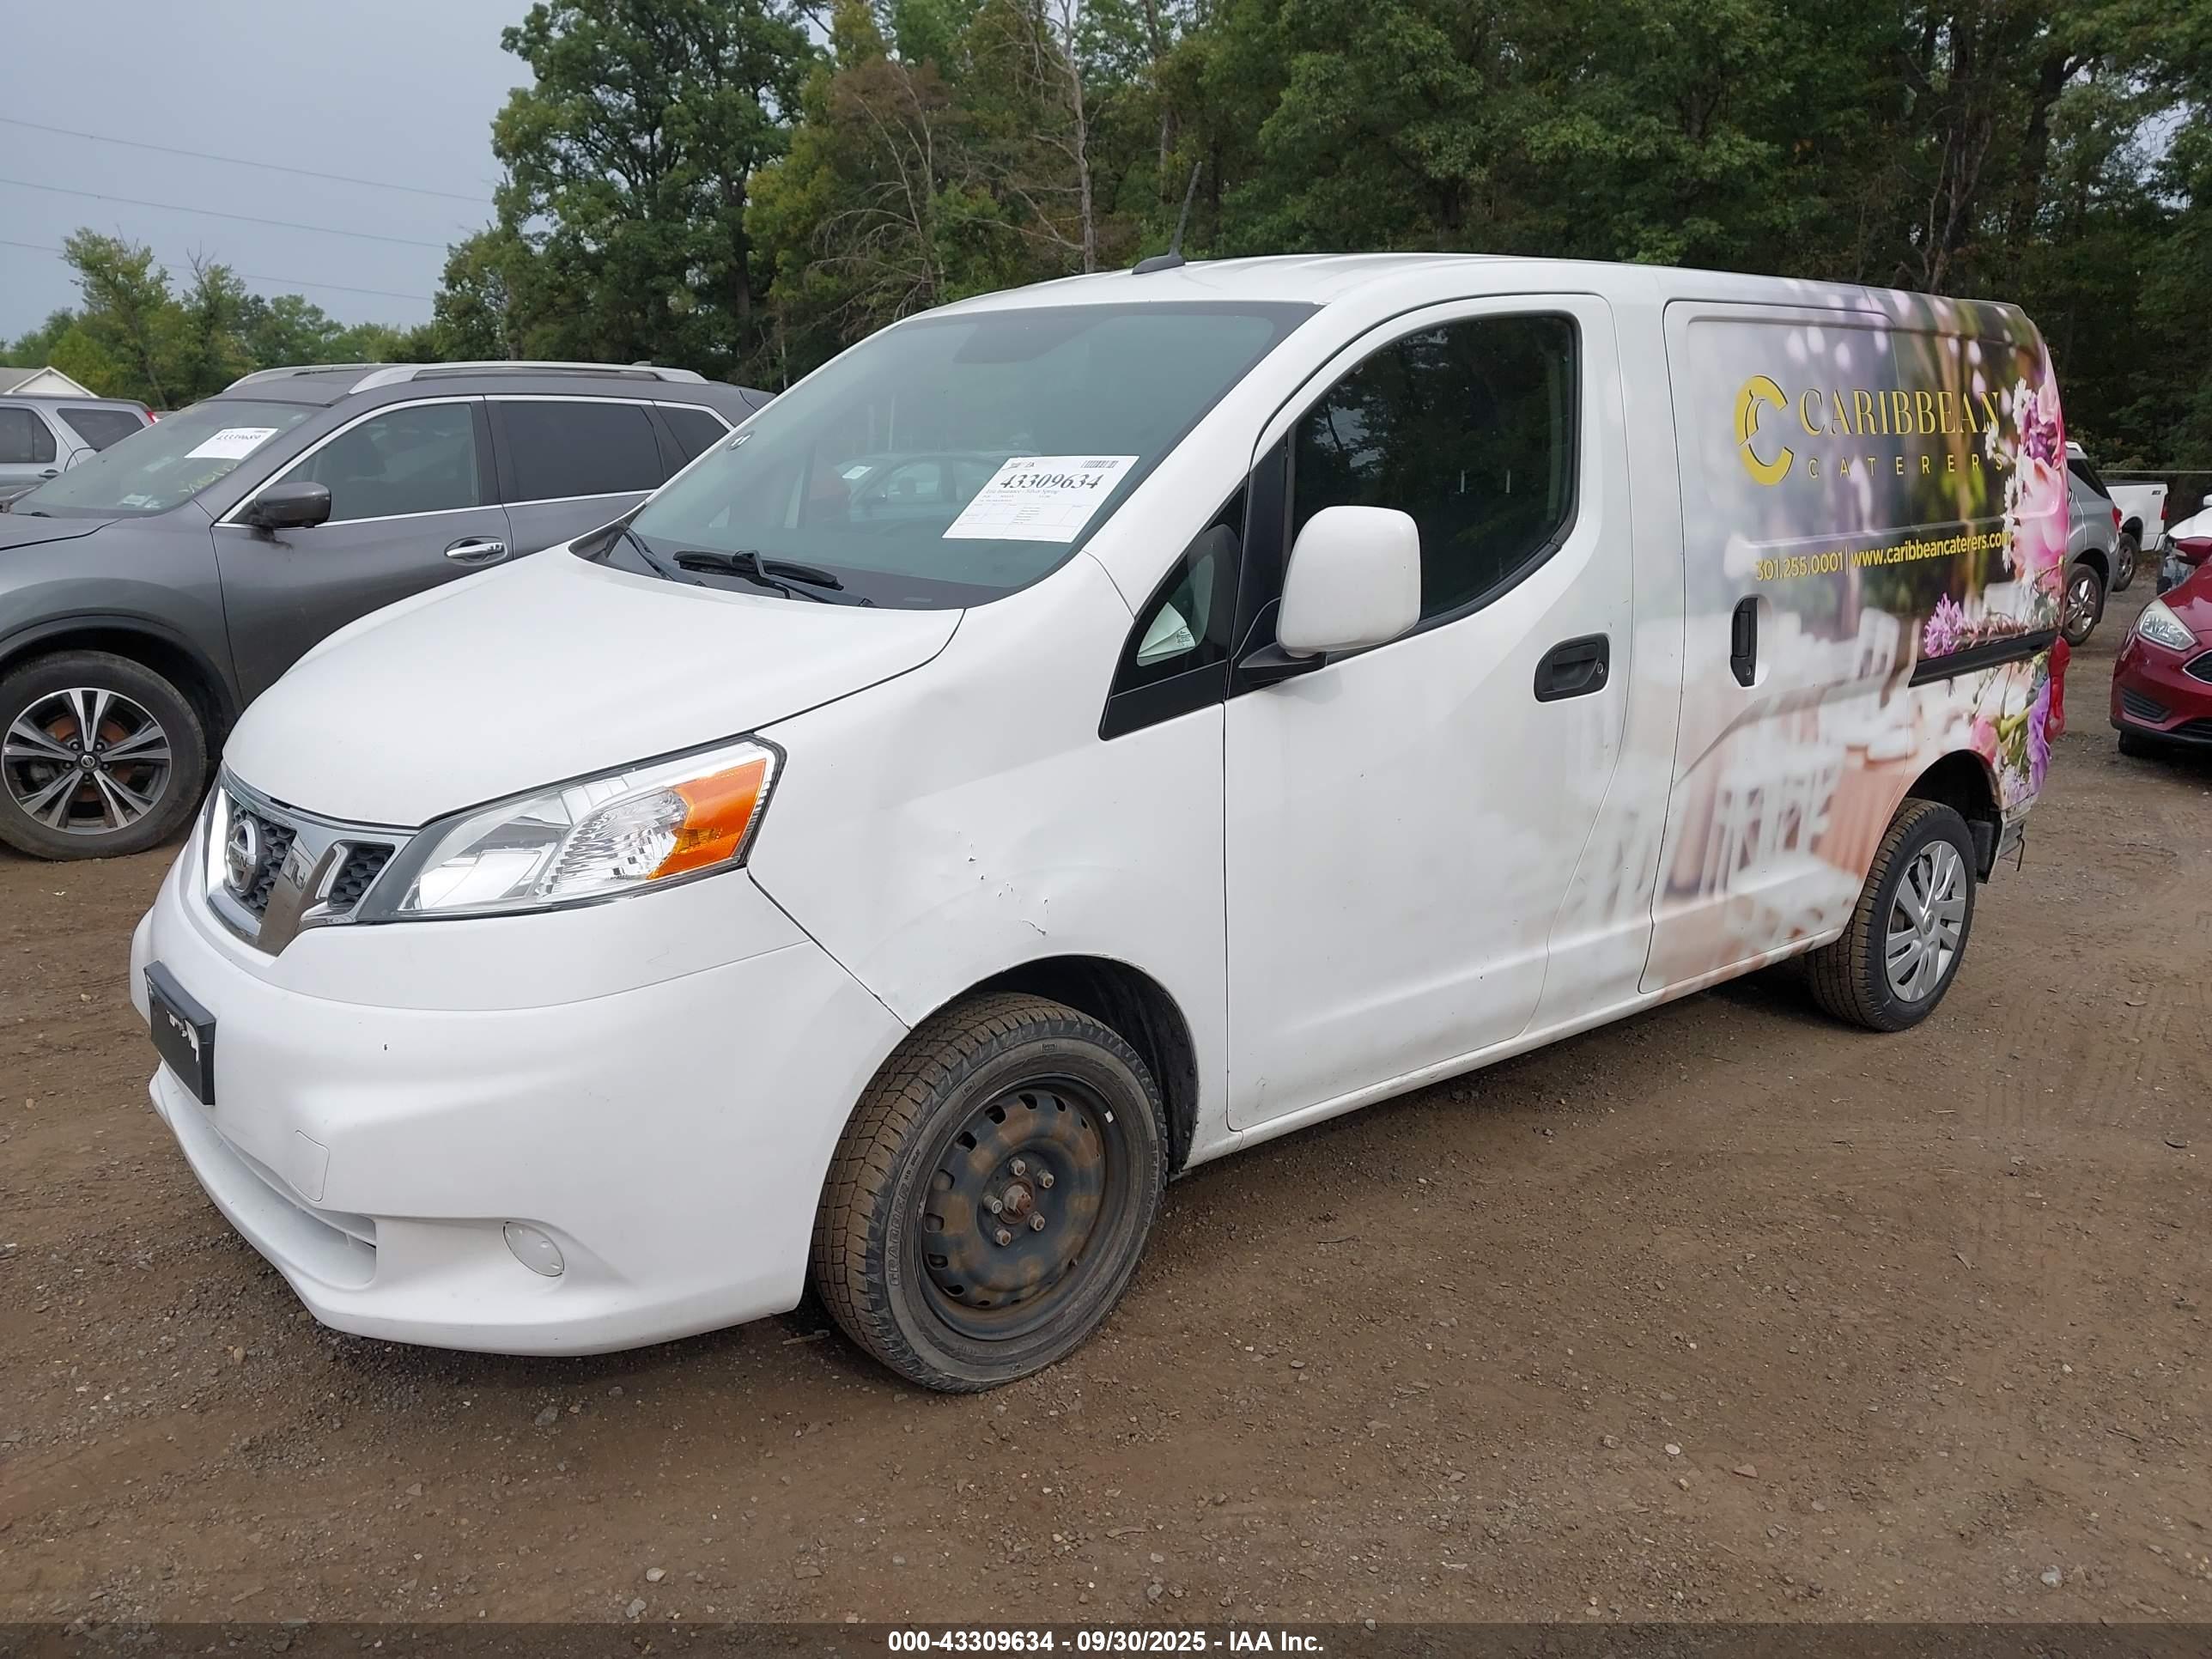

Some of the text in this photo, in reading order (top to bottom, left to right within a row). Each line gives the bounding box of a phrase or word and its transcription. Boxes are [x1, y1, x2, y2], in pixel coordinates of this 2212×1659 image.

[1799, 389, 1999, 436] CARIBBEAN
[1000, 473, 1104, 489] 43309634
[1808, 453, 2003, 478] CATERERS
[1757, 550, 1843, 581] 301.255.0001
[1850, 531, 2011, 568] www.caribbeancaterers.com
